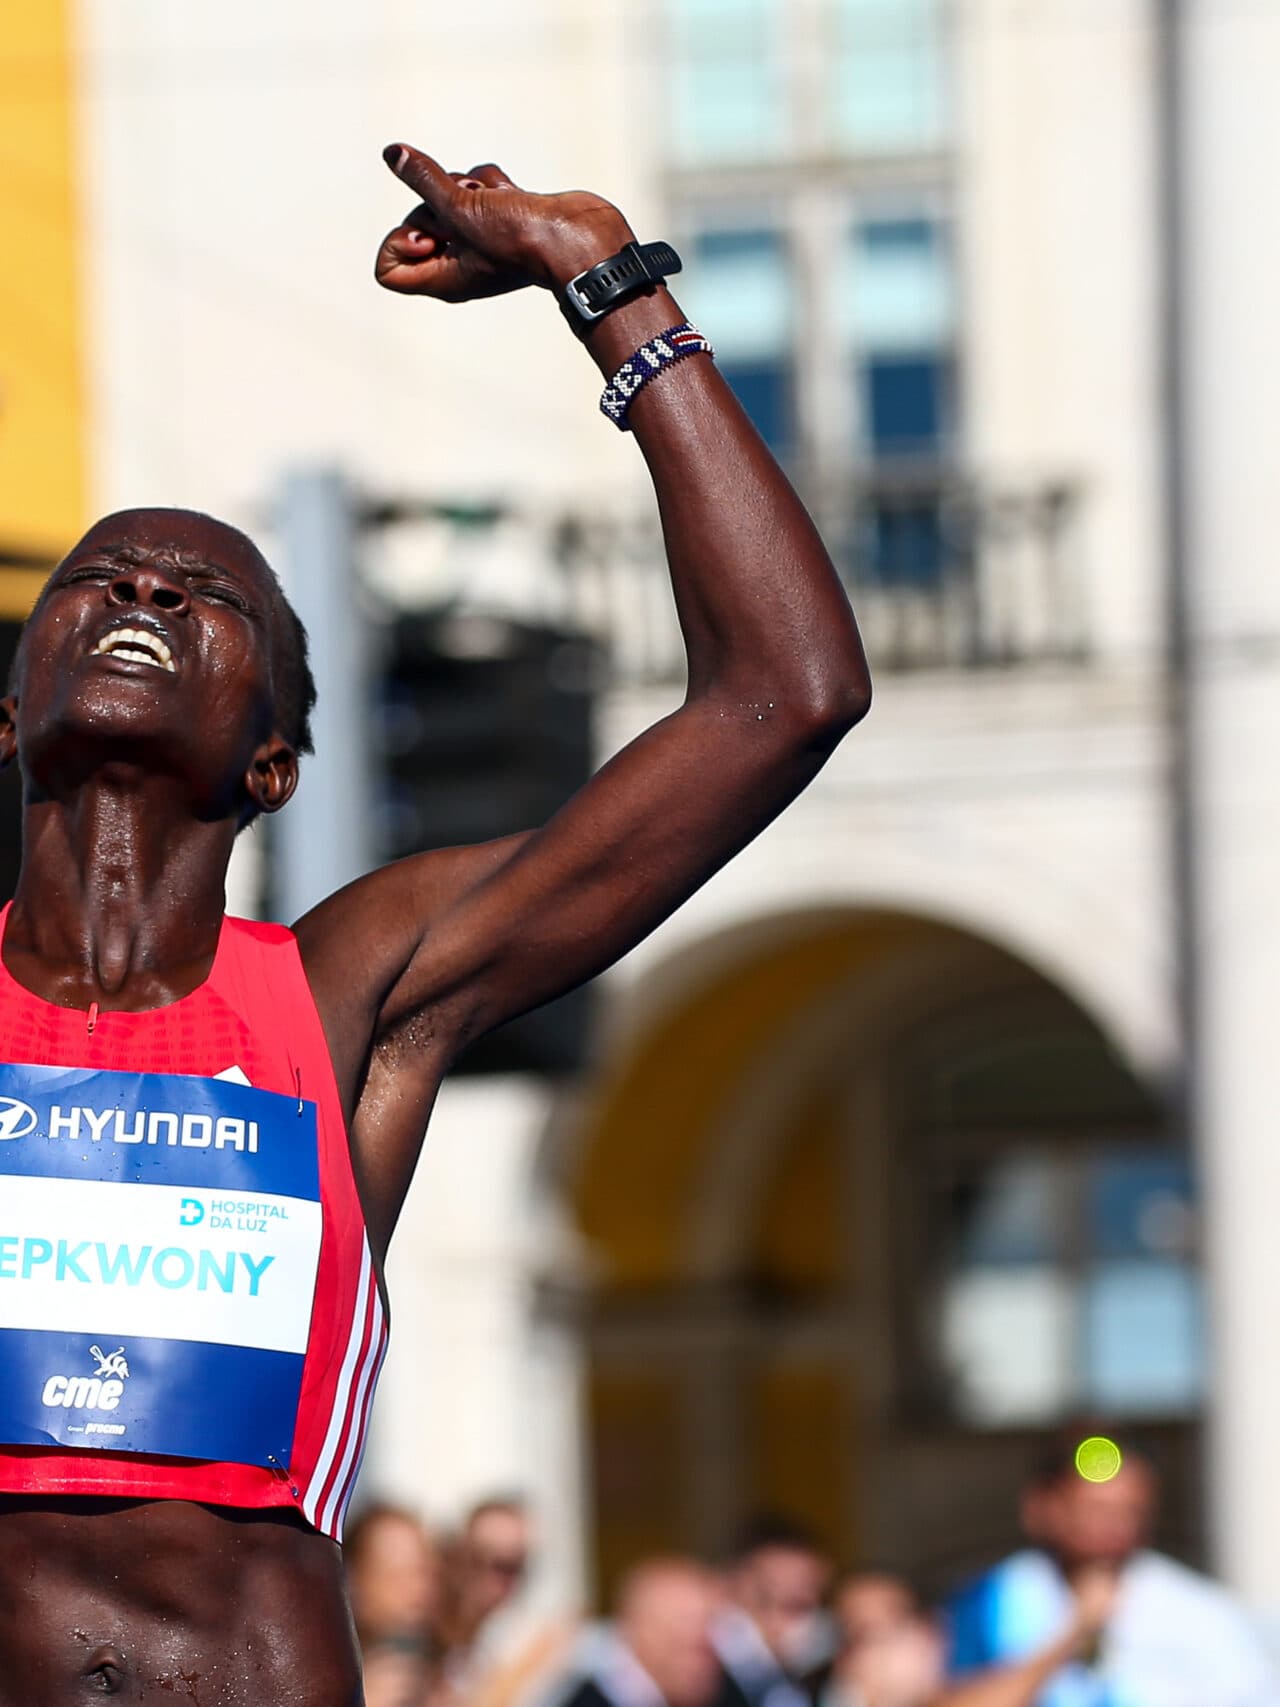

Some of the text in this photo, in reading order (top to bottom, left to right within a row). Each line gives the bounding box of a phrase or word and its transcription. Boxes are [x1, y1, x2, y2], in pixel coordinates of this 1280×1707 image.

[48, 1105, 259, 1153] HYUNDAI
[211, 1199, 289, 1219] HOSPITAL
[210, 1216, 268, 1233] DA LUZ
[42, 1375, 124, 1410] cme
